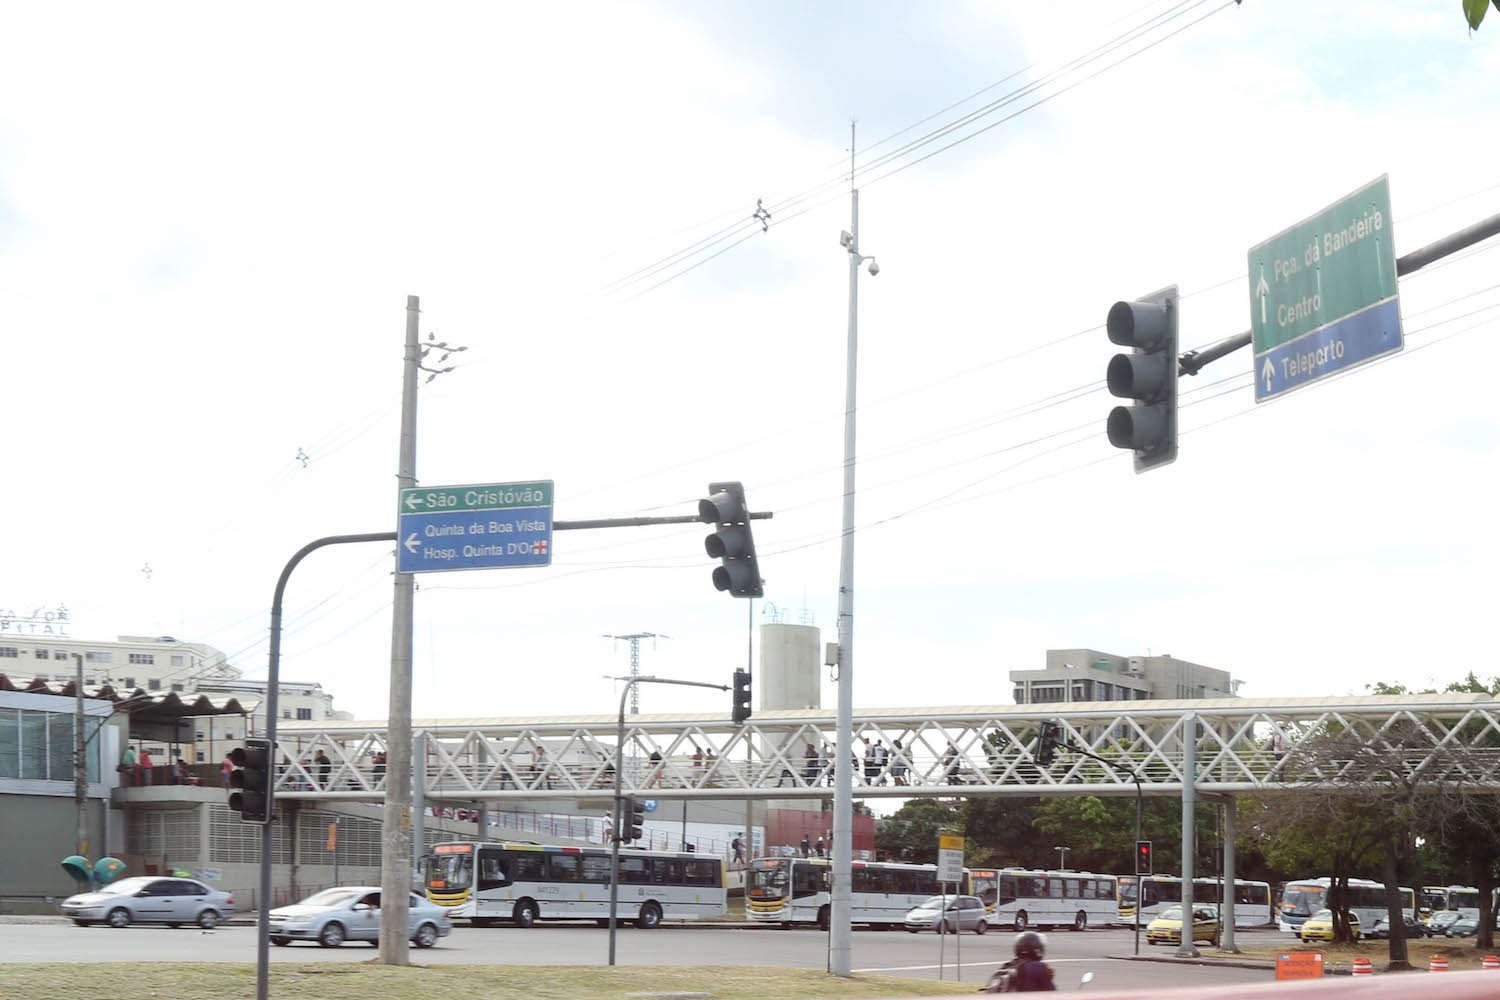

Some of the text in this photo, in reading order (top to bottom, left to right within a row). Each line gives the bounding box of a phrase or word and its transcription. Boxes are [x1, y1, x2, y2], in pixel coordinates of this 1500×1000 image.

[1304, 243, 1320, 267] da
[1324, 209, 1383, 257] Bandeira
[1277, 295, 1321, 327] Centro
[1281, 339, 1345, 380] Teleporto
[426, 488, 544, 508] São Cristóvão
[424, 519, 546, 537] Quinta da Boa Vista
[423, 547, 459, 560] Hosp.
[463, 544, 503, 558] Quinta
